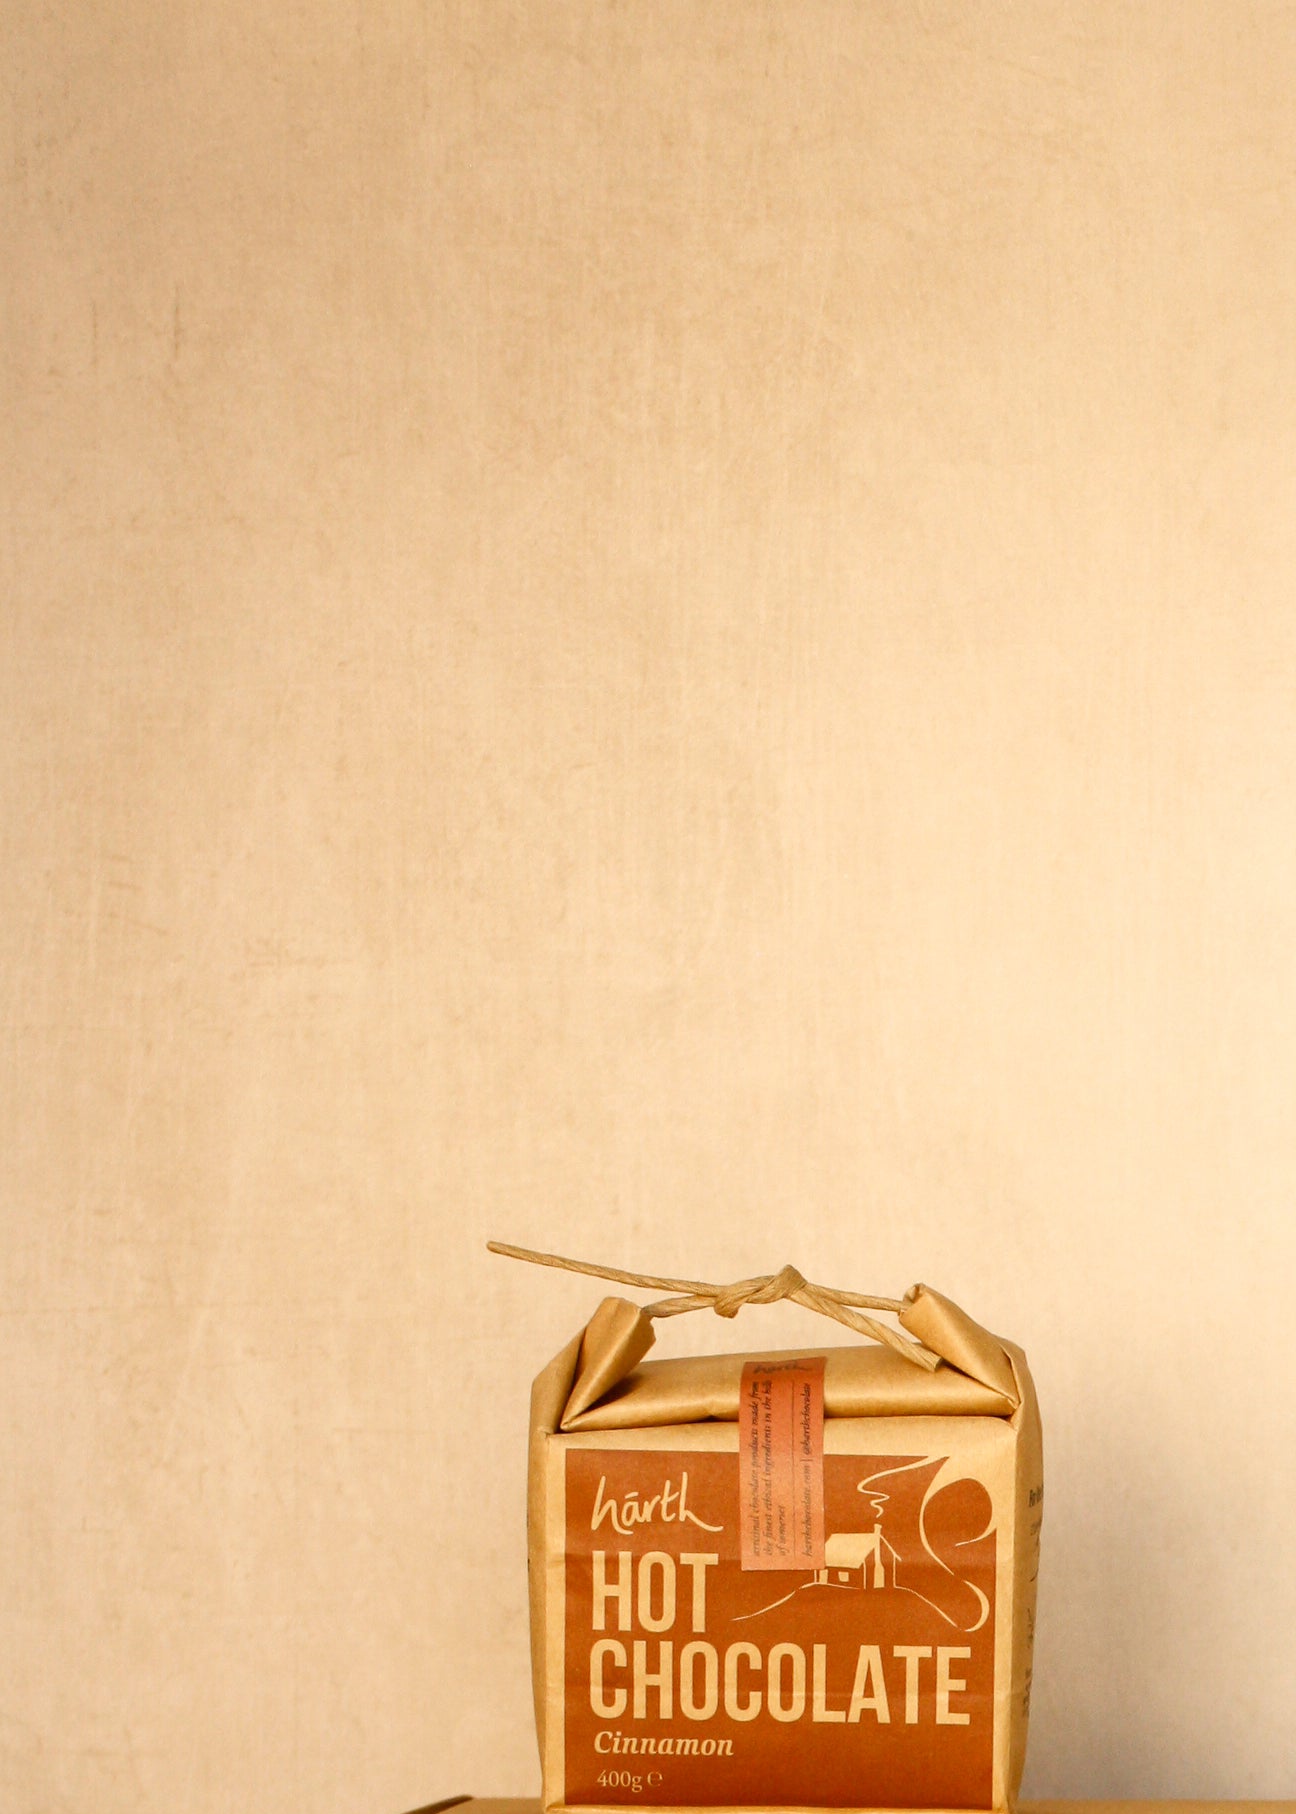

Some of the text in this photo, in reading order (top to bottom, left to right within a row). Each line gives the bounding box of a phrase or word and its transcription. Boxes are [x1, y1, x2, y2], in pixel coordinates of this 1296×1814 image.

[592, 1550, 719, 1632] HOT
[590, 1638, 972, 1725] CHOCOLATE
[594, 1731, 734, 1756] Cinnamon
[597, 1770, 642, 1793] 400g
